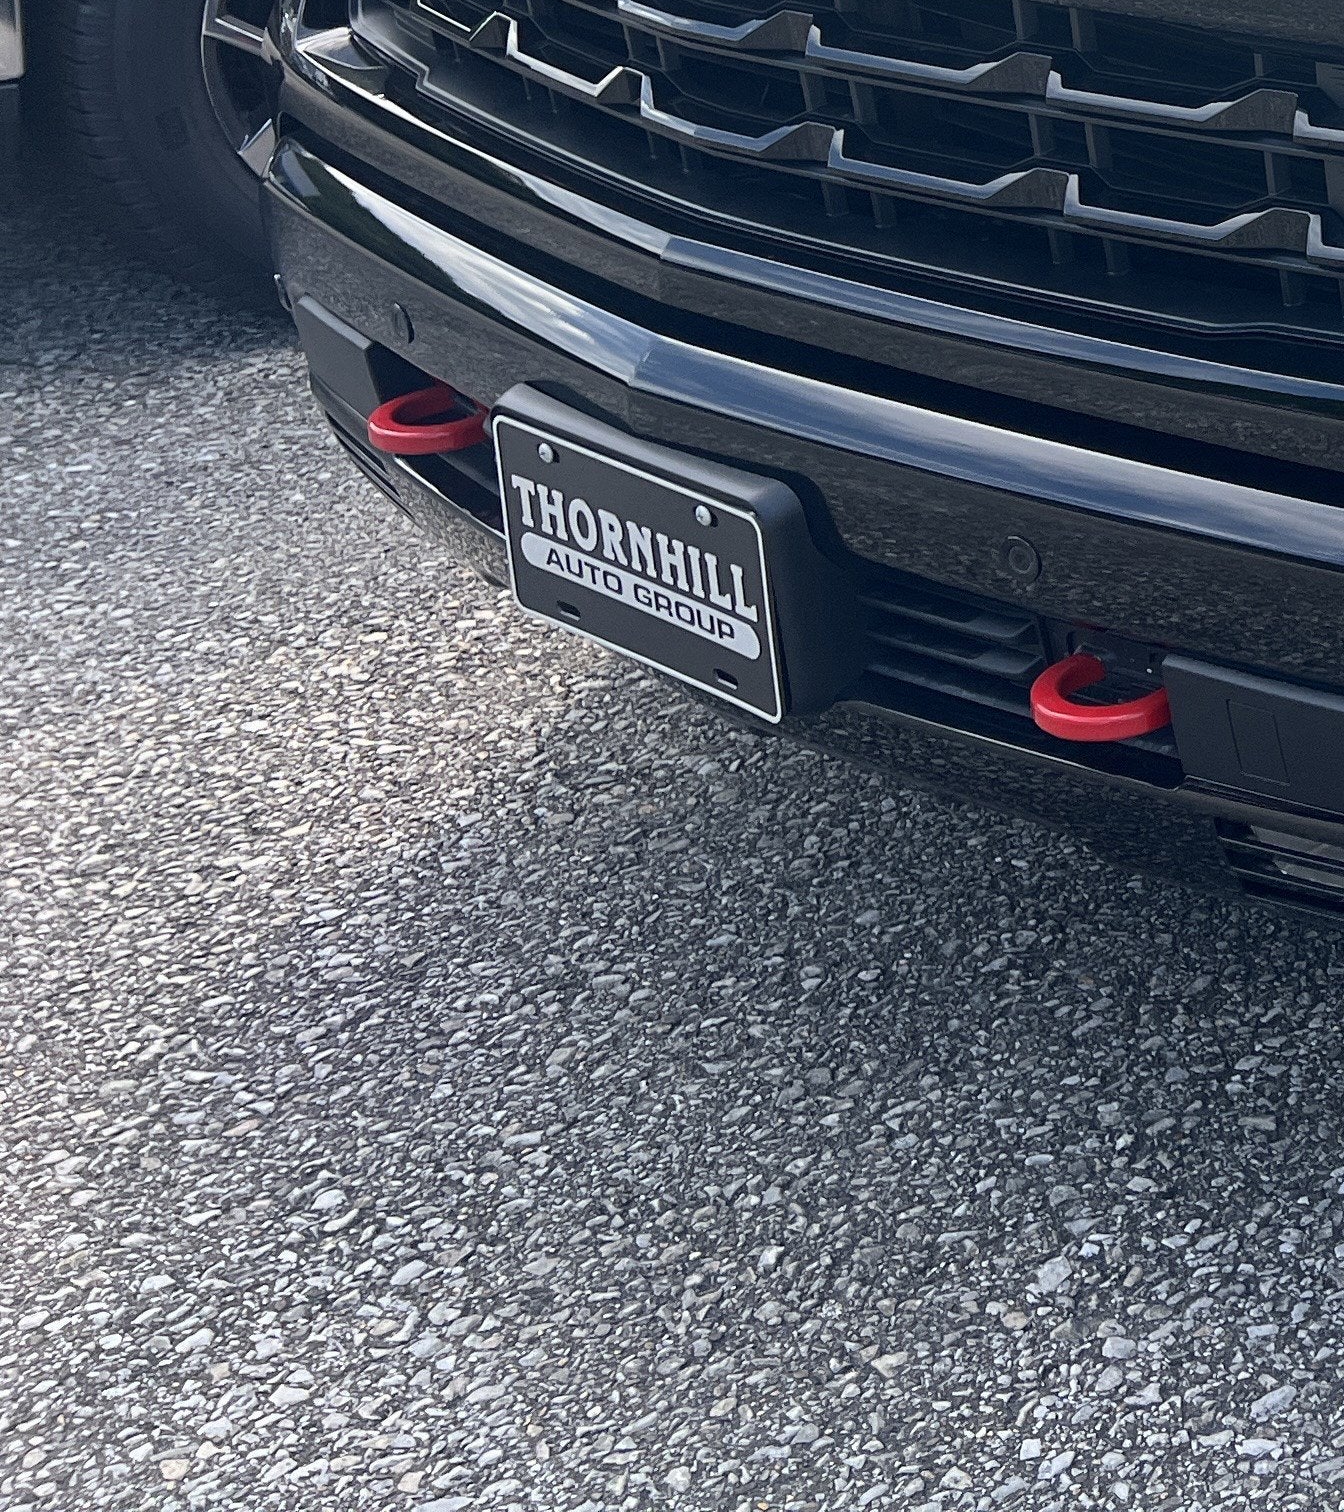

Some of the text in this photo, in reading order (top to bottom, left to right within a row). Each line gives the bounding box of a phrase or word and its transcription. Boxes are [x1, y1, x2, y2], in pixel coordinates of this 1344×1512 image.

[511, 474, 759, 623] THORNHILL
[546, 547, 735, 640] AUTO GROUP
